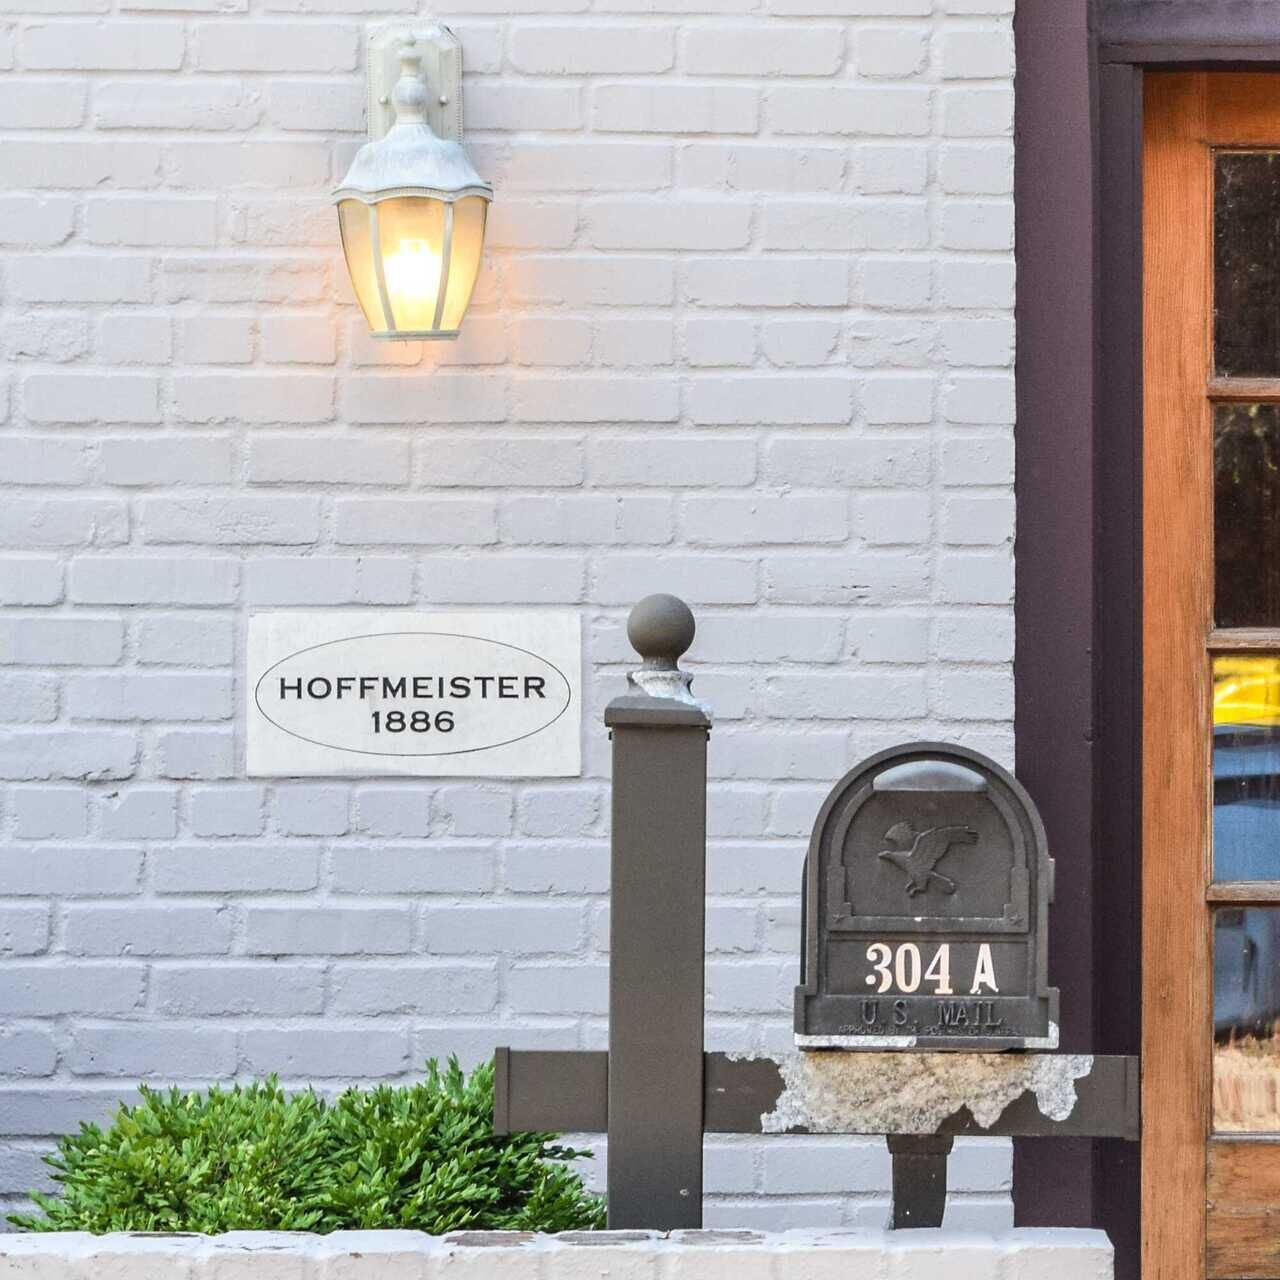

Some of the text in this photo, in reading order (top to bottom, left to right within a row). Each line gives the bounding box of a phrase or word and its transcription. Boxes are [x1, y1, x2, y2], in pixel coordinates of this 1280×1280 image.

[279, 675, 546, 700] HOFFMEISTER
[371, 710, 455, 734] 1886
[865, 943, 999, 994] 304 A
[936, 1000, 1003, 1026] MAIL
